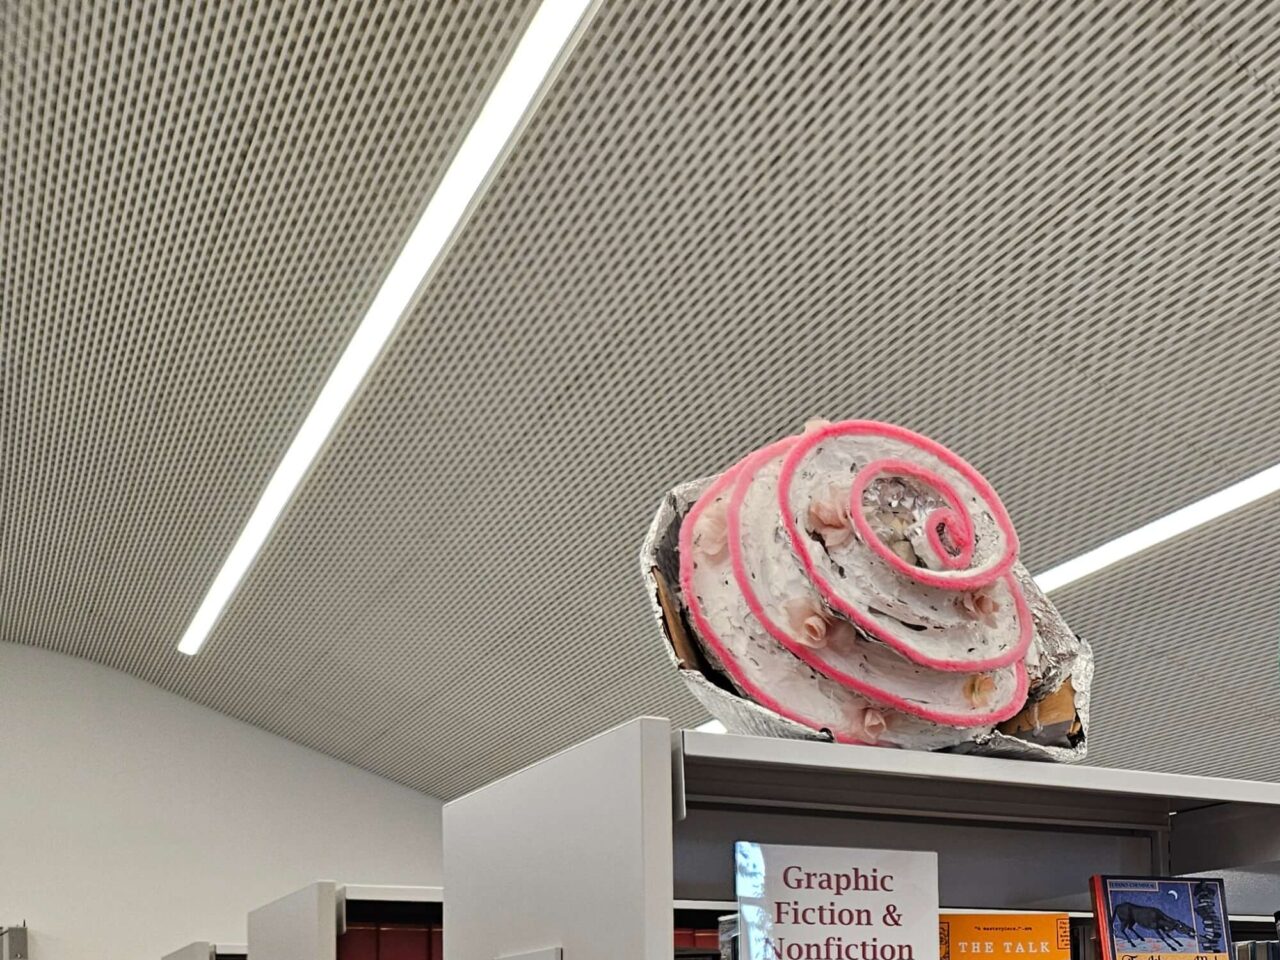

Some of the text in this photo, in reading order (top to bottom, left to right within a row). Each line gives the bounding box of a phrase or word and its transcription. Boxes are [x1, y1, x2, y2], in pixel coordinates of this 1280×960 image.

[783, 865, 894, 895] Graphic
[774, 902, 903, 928] Fiction &
[959, 942, 1051, 953] THE TALK
